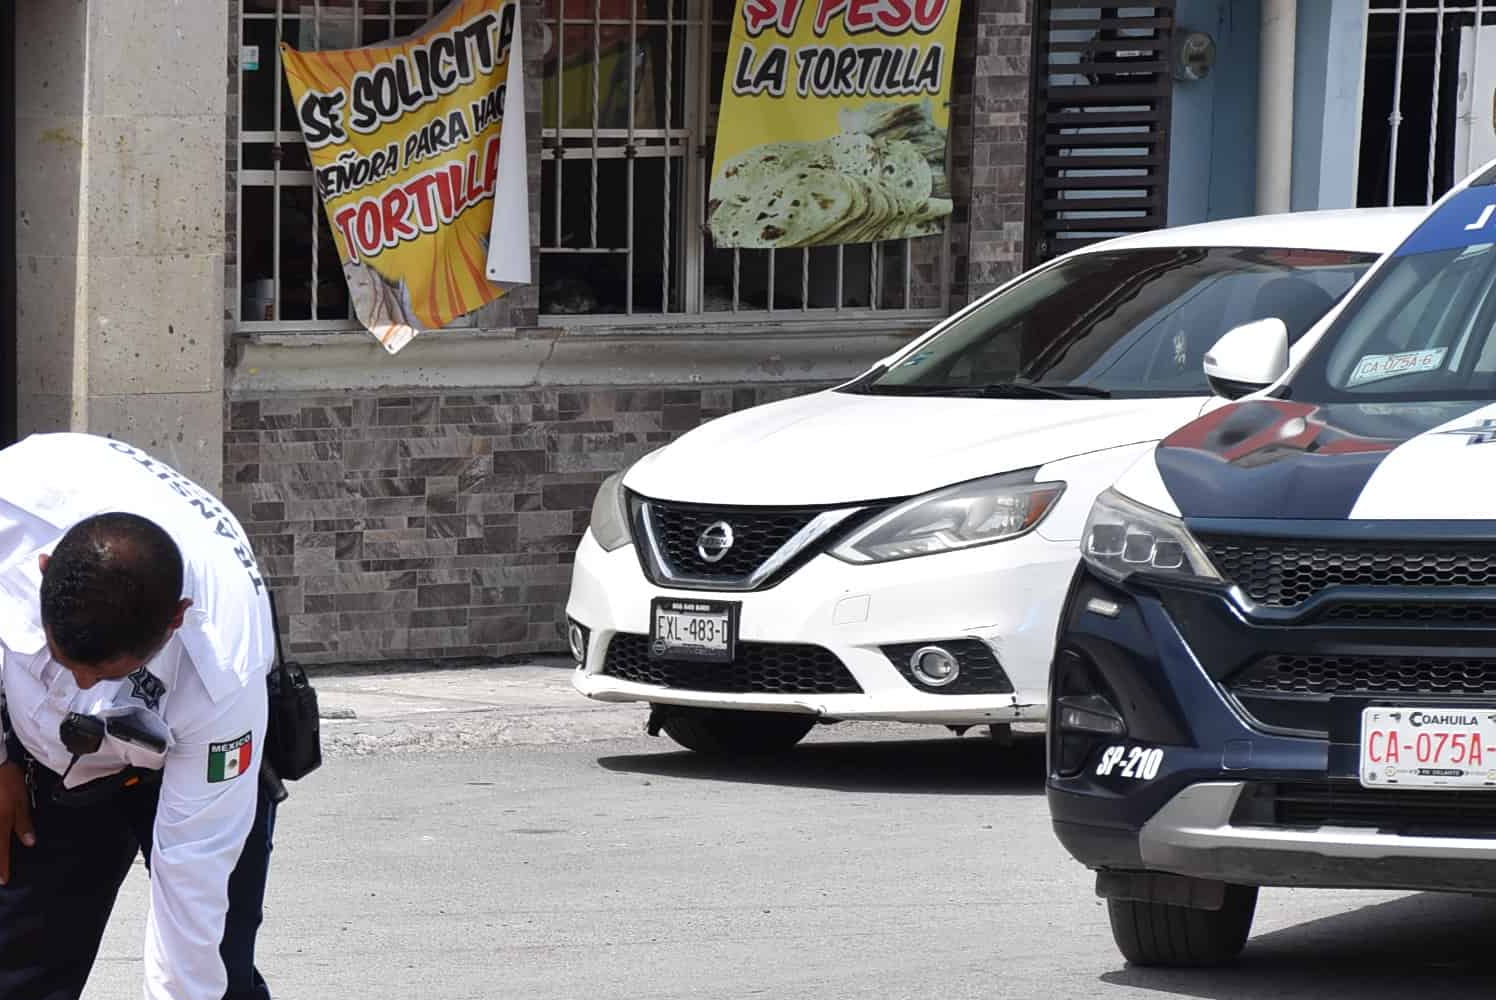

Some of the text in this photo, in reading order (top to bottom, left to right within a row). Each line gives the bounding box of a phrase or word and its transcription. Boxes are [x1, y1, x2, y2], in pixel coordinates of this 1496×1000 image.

[300, 2, 516, 145] SE SOLICITA
[735, 45, 942, 91] LA TORTILLA
[404, 111, 469, 166] PARA
[1095, 745, 1165, 781] SP-210
